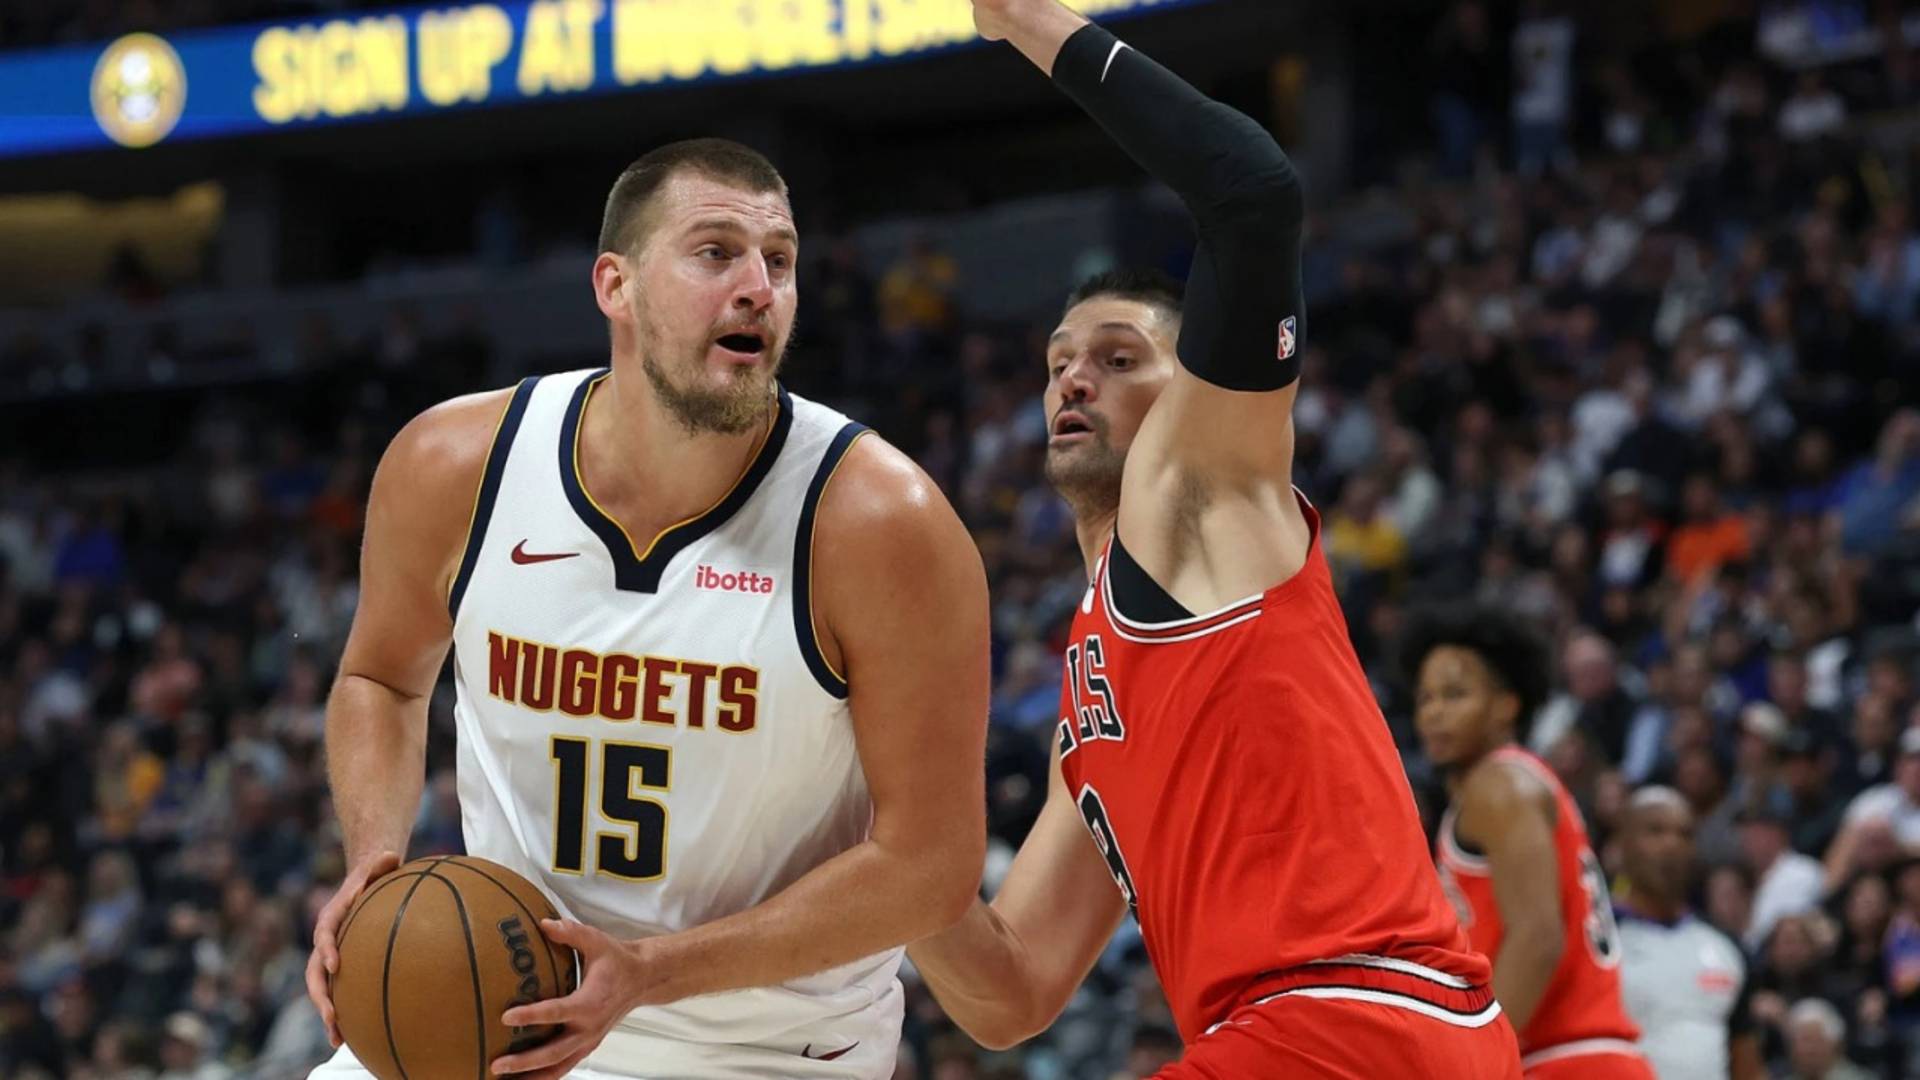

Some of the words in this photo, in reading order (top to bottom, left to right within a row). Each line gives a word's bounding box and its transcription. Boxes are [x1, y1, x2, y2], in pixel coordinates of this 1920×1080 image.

[252, 17, 410, 123] SIGN
[416, 5, 514, 106] UP
[517, 0, 603, 95] AT
[696, 564, 774, 594] ibotta
[487, 628, 760, 736] NUGGETS
[549, 733, 673, 882] 15
